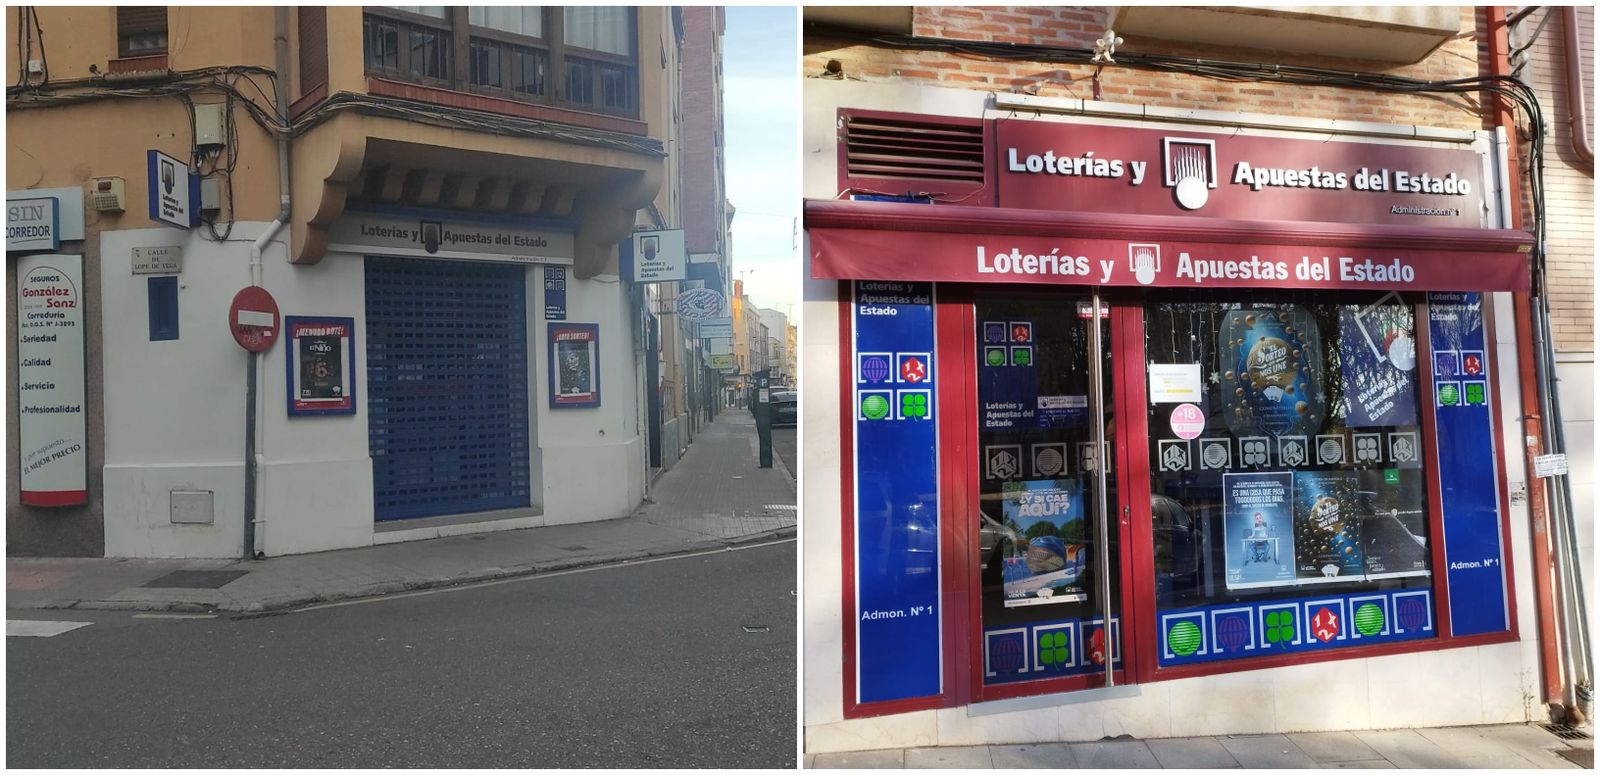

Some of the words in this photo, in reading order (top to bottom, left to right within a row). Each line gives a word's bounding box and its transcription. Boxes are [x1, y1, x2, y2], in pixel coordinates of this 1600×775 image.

[1008, 148, 1124, 177] Loterías
[1130, 160, 1147, 185] y
[1234, 161, 1347, 190] Apuestas
[1354, 167, 1389, 191] del
[1395, 170, 1471, 195] Estado
[8, 205, 45, 221] SIN
[411, 230, 418, 242] y
[444, 231, 492, 245] Apuestas
[495, 234, 511, 245] del
[514, 235, 547, 248] Estado
[976, 246, 1090, 276] Loterías
[1100, 259, 1114, 283] y
[1176, 252, 1289, 283] Apuestas
[1295, 256, 1330, 281] del
[1339, 257, 1415, 282] Estado
[30, 275, 60, 283] SEGUROS
[22, 286, 70, 297] González
[46, 298, 75, 308] Sanz
[861, 293, 910, 305] Apuestas
[913, 295, 929, 304] del
[860, 306, 898, 316] Estado
[1431, 312, 1458, 321] Estado
[23, 334, 57, 343] Seriedad
[23, 357, 51, 367] Calidad
[24, 382, 55, 391] Servicio
[761, 378, 768, 387] P
[24, 405, 80, 414] Profesionalidad
[986, 402, 1016, 410] Loterías
[1369, 401, 1394, 421] Estado
[986, 411, 1021, 420] Apuestas
[1023, 409, 1034, 417] del
[52, 444, 80, 461] PRECIO
[1034, 495, 1044, 503] SI
[1046, 494, 1068, 503] CAE
[1450, 562, 1482, 570] Admon.
[1495, 558, 1499, 566] 1
[861, 610, 907, 621] Admon.
[927, 605, 933, 615] 1
